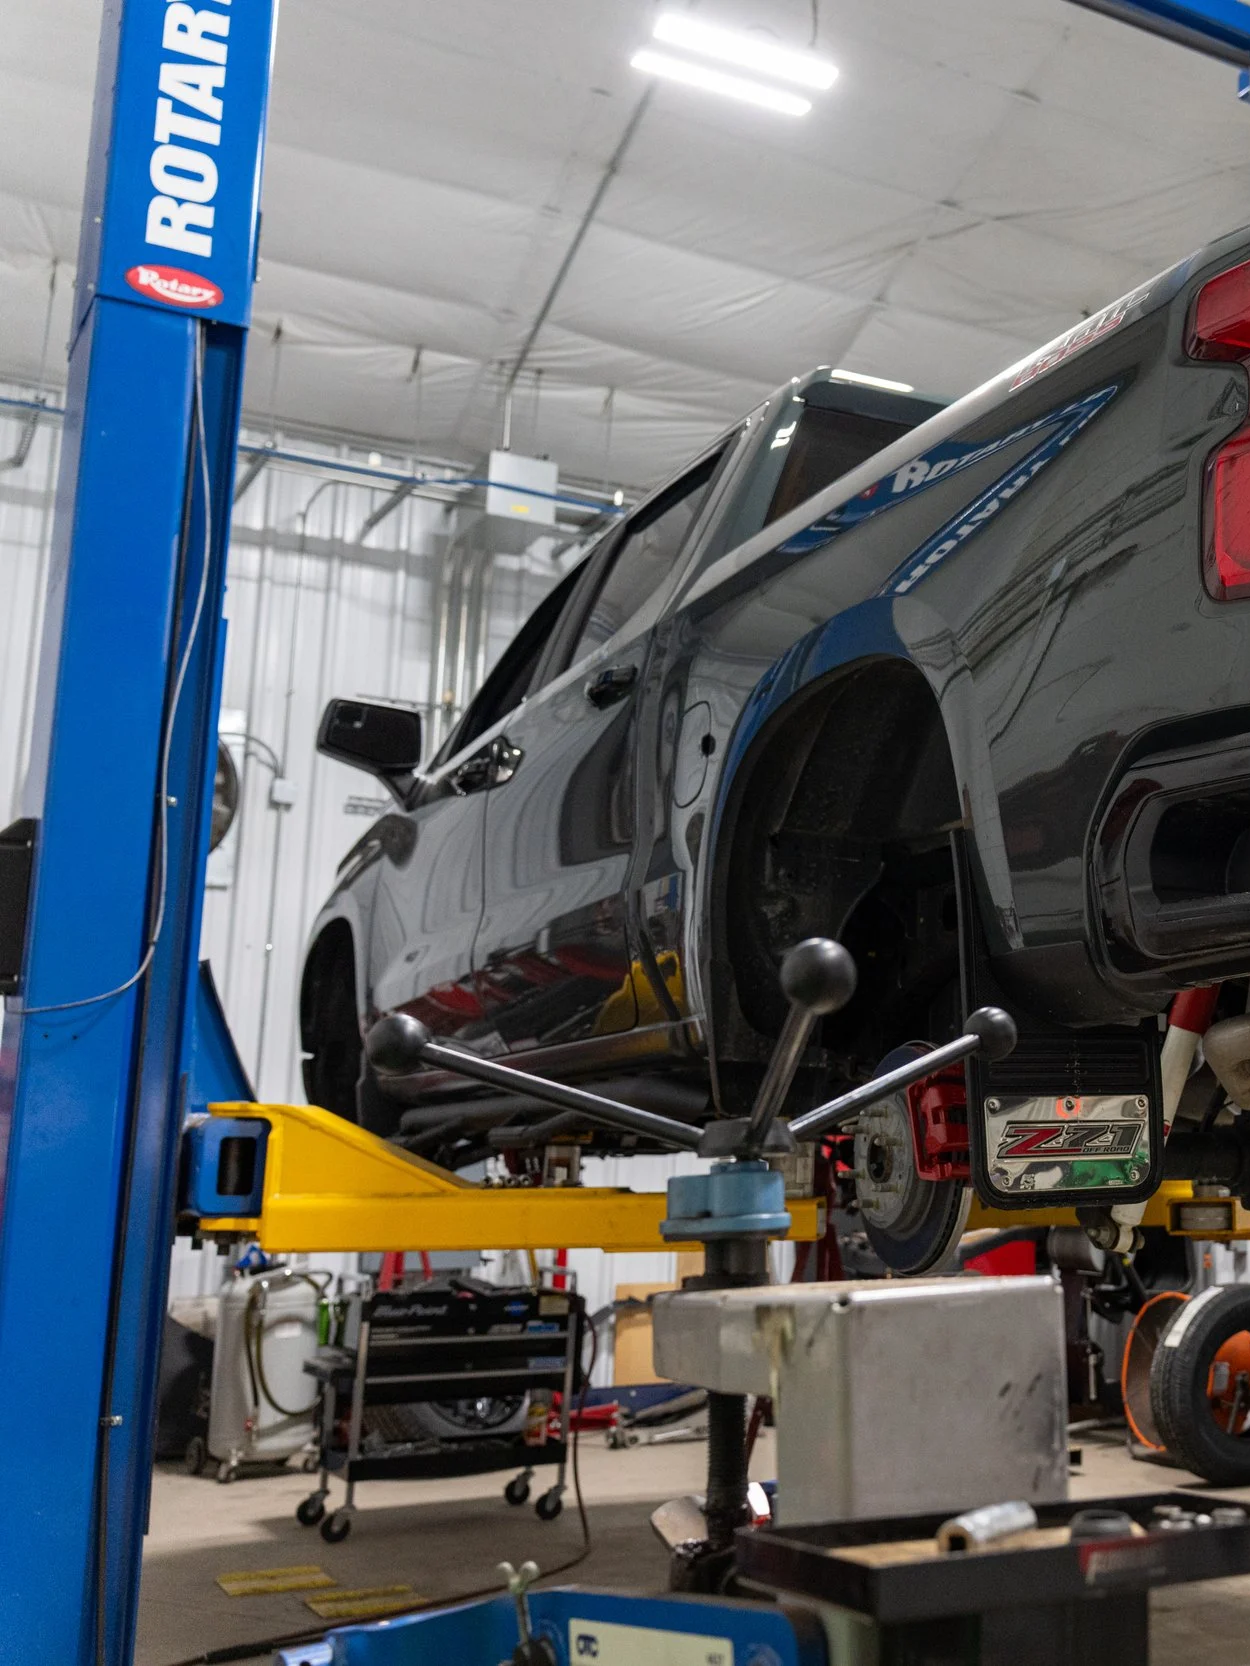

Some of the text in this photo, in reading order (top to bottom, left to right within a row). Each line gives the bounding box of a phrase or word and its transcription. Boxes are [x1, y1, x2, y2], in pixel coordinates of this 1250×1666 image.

[145, 0, 232, 258] ROTAR
[137, 266, 216, 303] Rotary
[998, 1123, 1142, 1157] Z71
